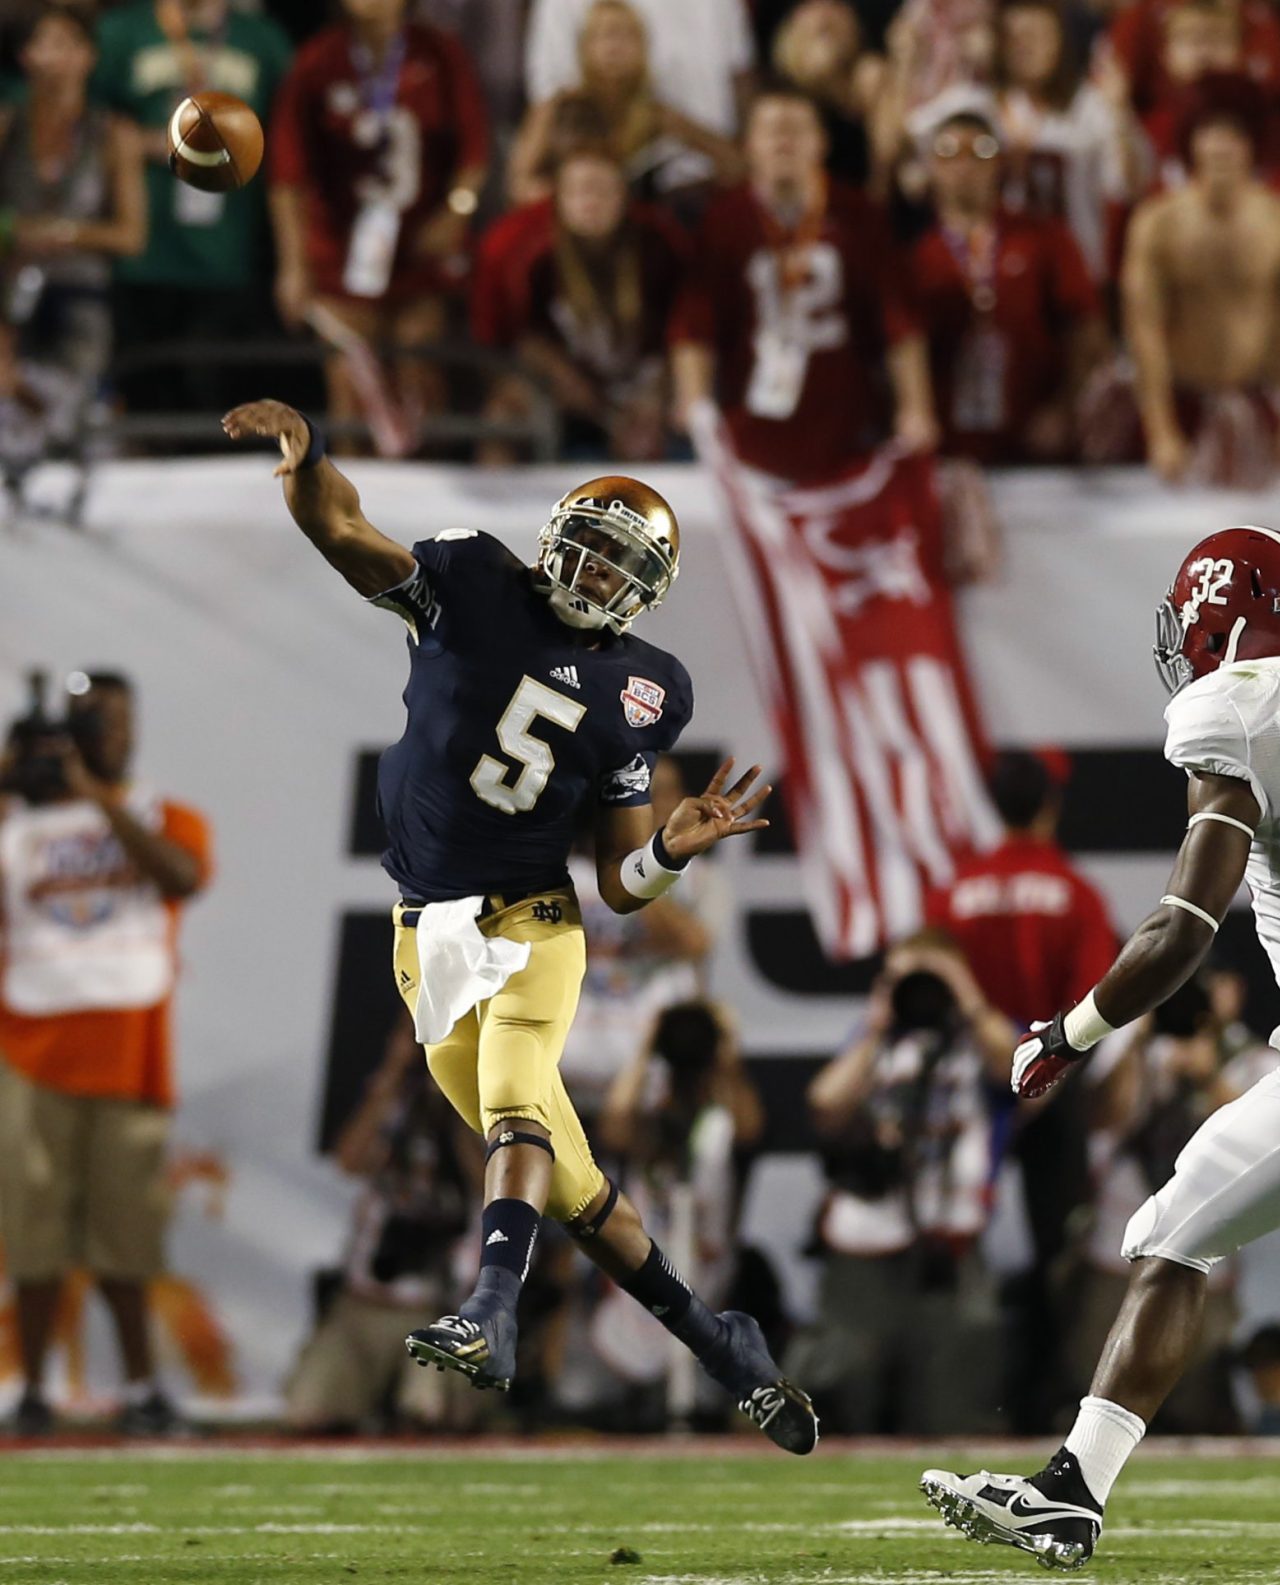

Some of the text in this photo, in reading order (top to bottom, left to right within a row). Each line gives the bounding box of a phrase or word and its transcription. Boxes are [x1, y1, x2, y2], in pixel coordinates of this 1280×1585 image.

[747, 244, 848, 350] 12
[620, 509, 648, 529] IRISH
[1190, 557, 1234, 606] 32
[549, 669, 581, 690] adidas
[632, 687, 658, 705] BCS
[469, 674, 588, 815] 5
